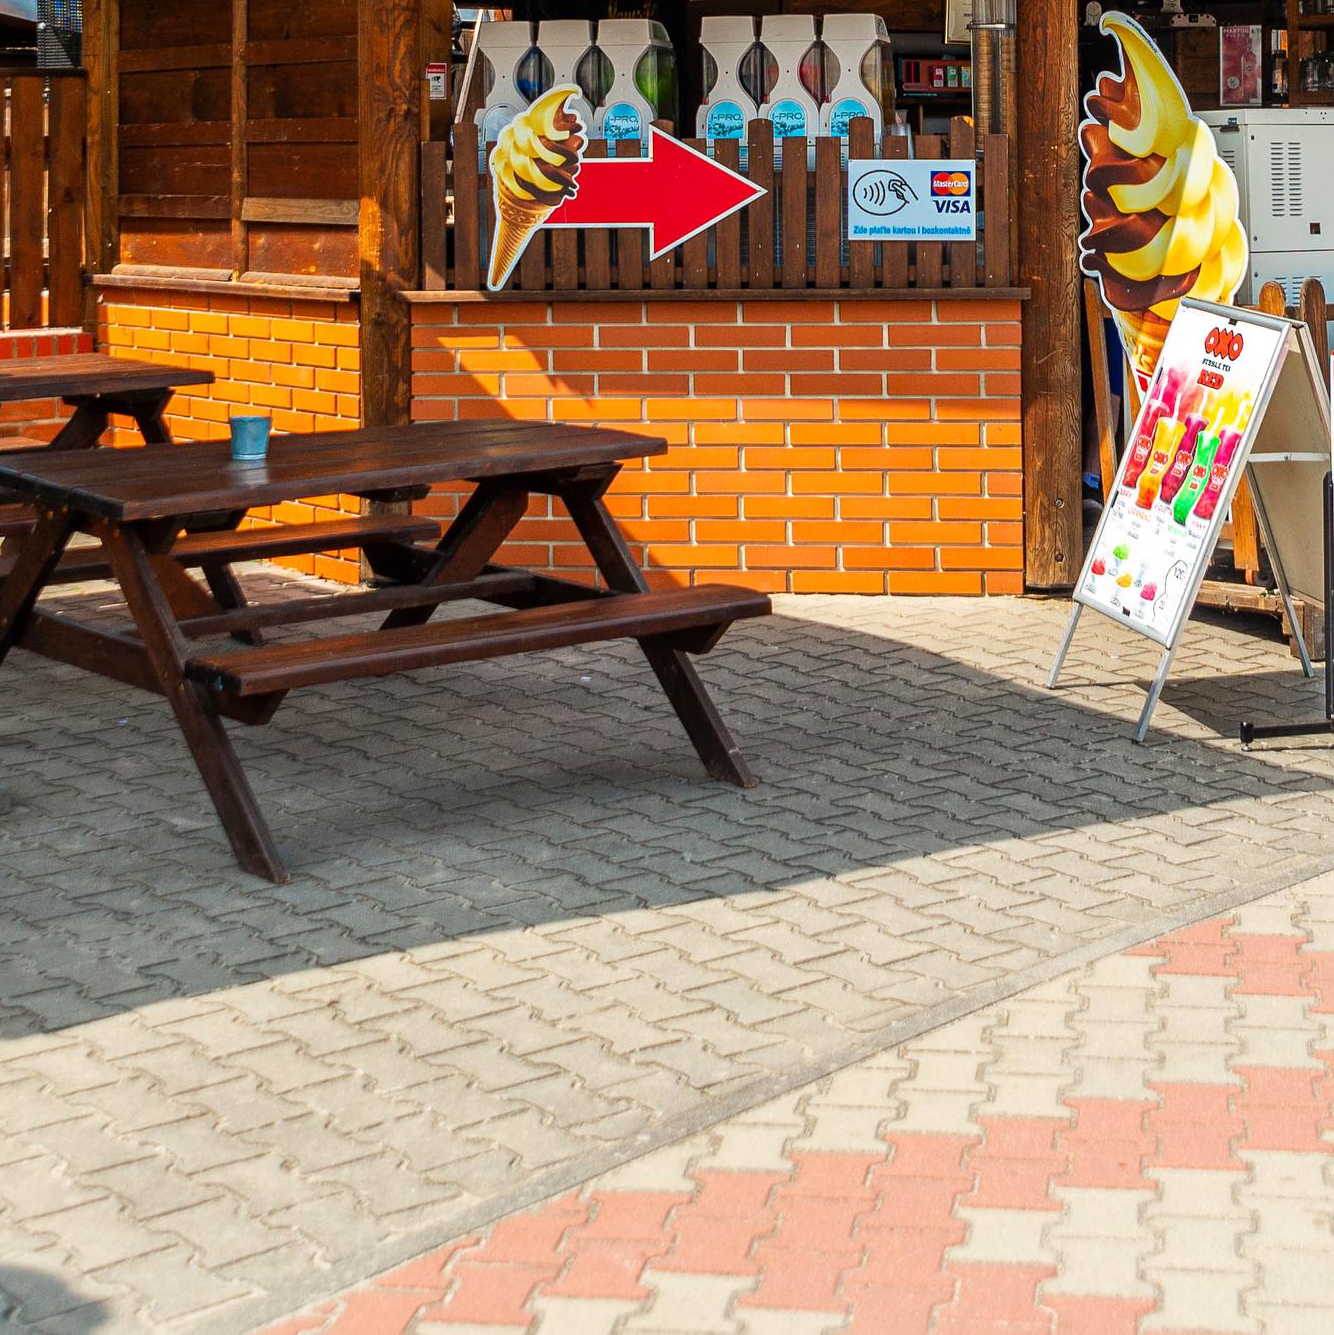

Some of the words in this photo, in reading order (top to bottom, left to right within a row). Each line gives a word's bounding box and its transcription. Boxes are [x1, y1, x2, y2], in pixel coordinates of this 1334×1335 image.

[933, 200, 971, 214] VISA
[853, 226, 868, 235] Zde
[892, 226, 917, 235] kartou
[1204, 326, 1244, 361] OXO
[1197, 368, 1225, 390] RED
